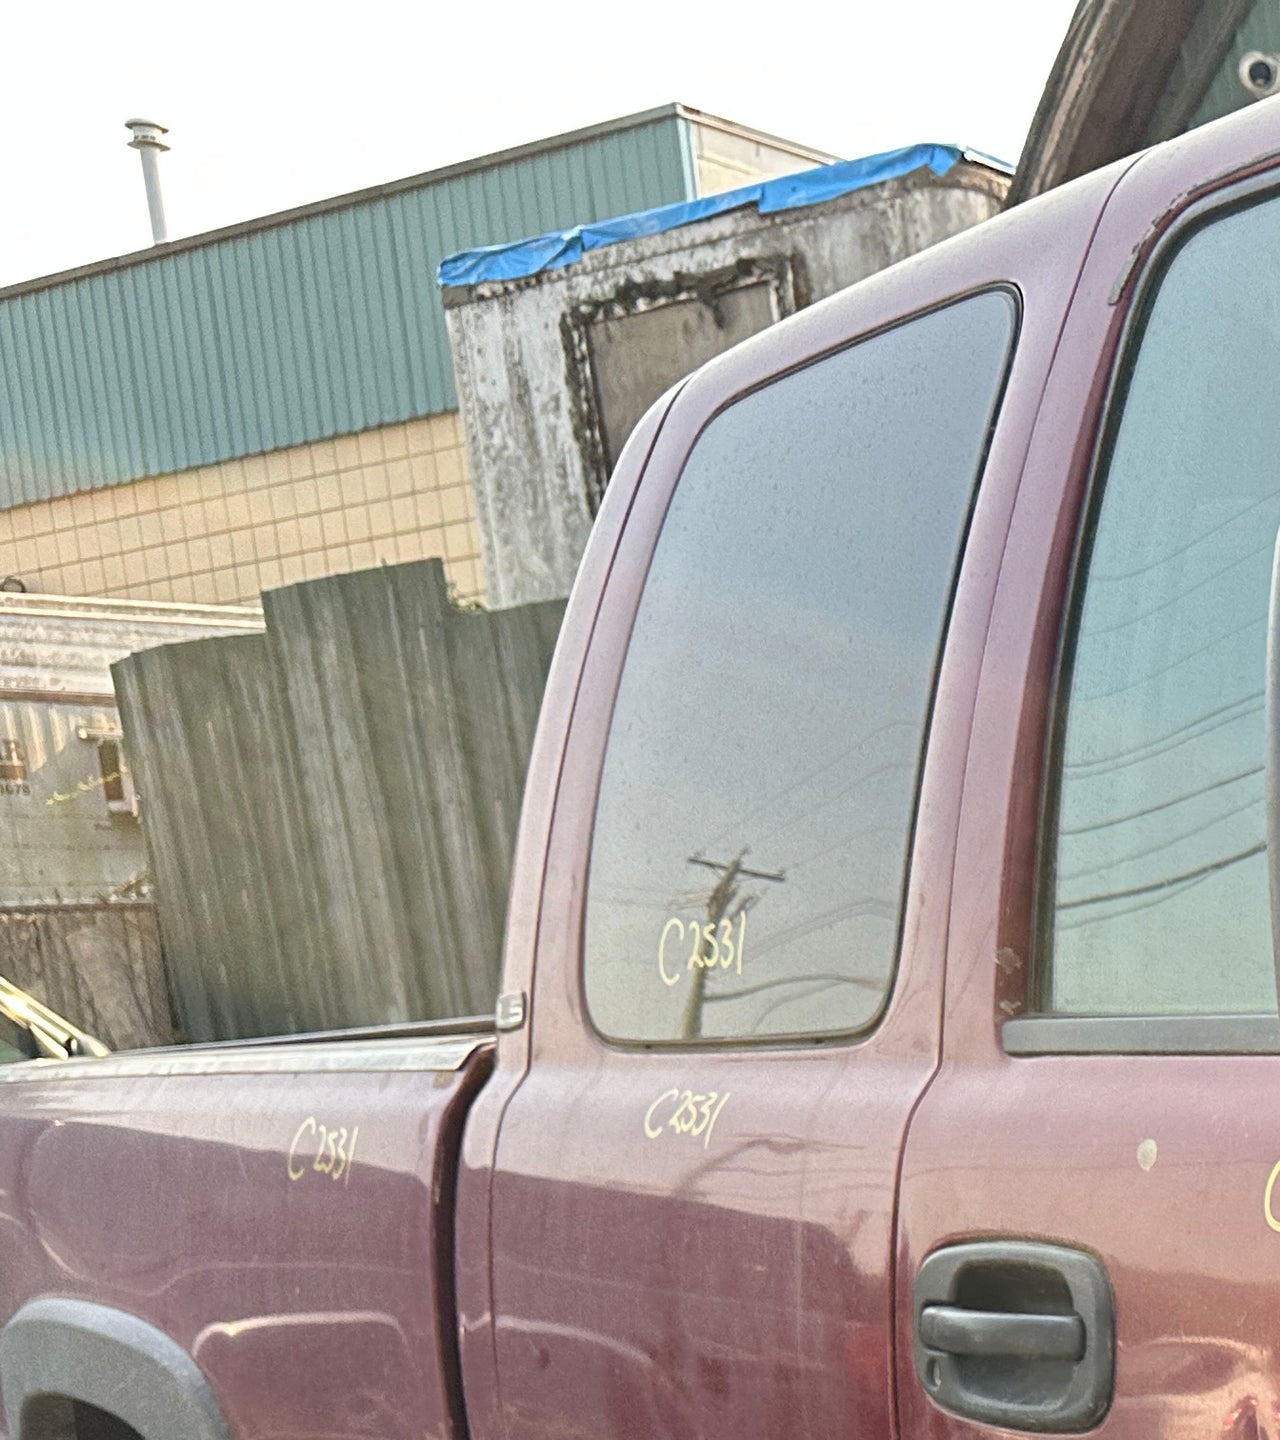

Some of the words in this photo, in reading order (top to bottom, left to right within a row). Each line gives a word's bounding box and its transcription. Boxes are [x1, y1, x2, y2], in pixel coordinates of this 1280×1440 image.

[659, 909, 746, 986] C2531
[288, 1116, 359, 1185] C2531
[644, 1088, 731, 1149] C2531
